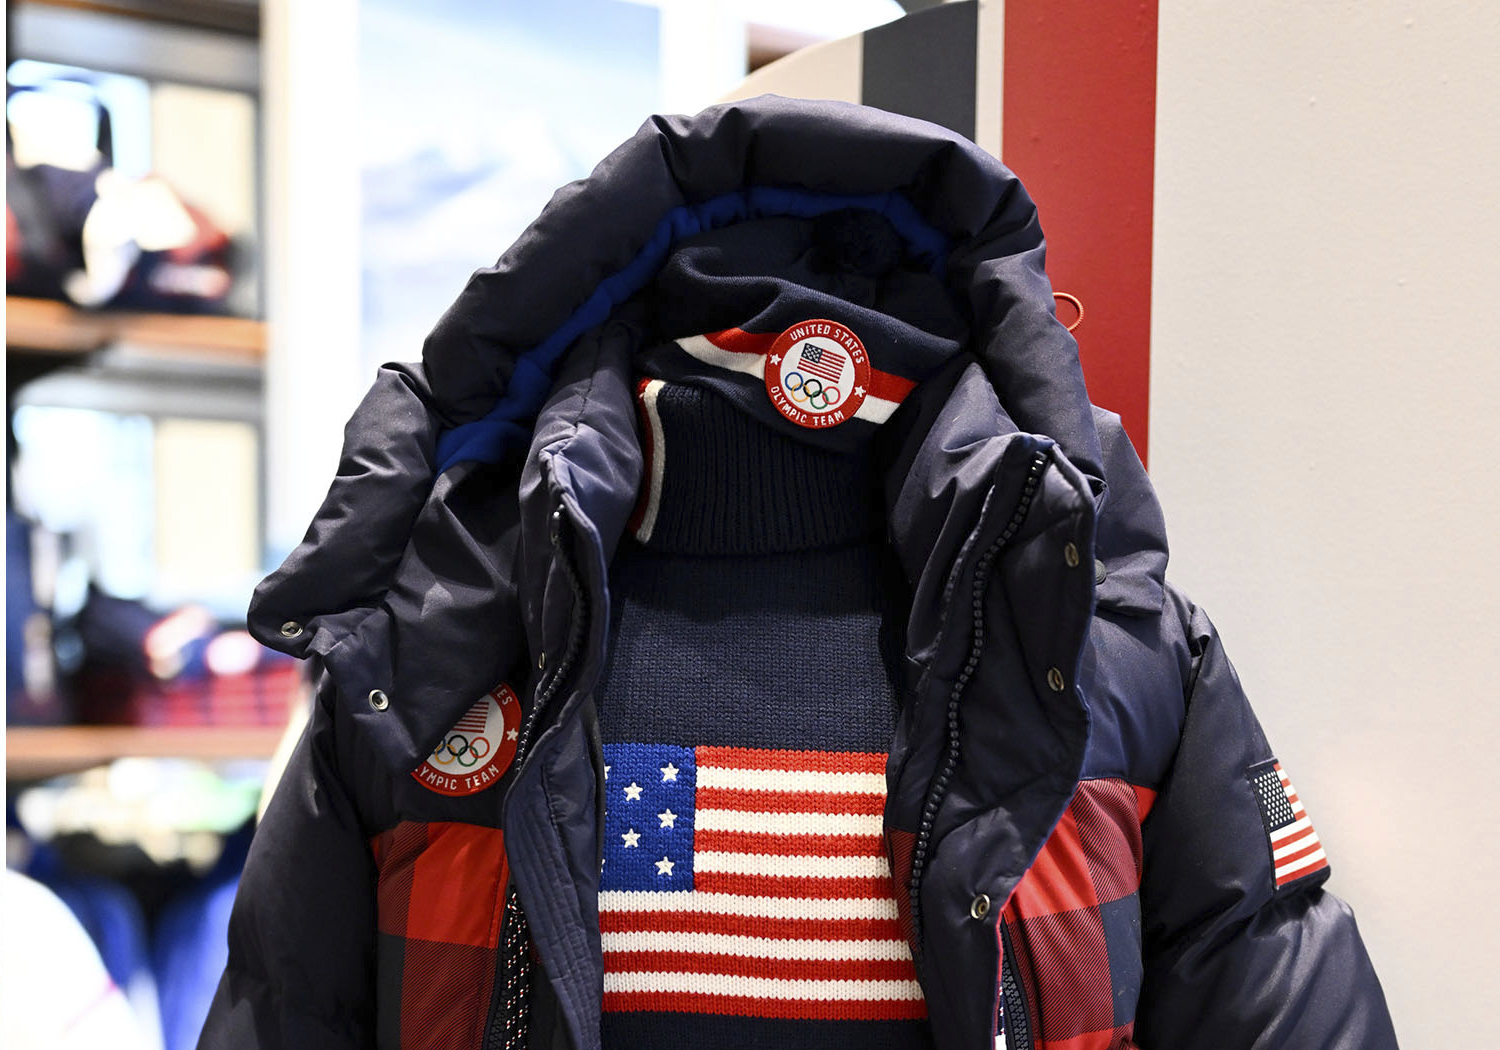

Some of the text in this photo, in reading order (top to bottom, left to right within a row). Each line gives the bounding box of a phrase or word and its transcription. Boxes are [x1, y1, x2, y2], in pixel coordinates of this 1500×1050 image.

[790, 324, 865, 364] UNITED STATES
[770, 386, 844, 426] OLYMPIC TEAM
[414, 764, 499, 791] YMPIC TEAM
